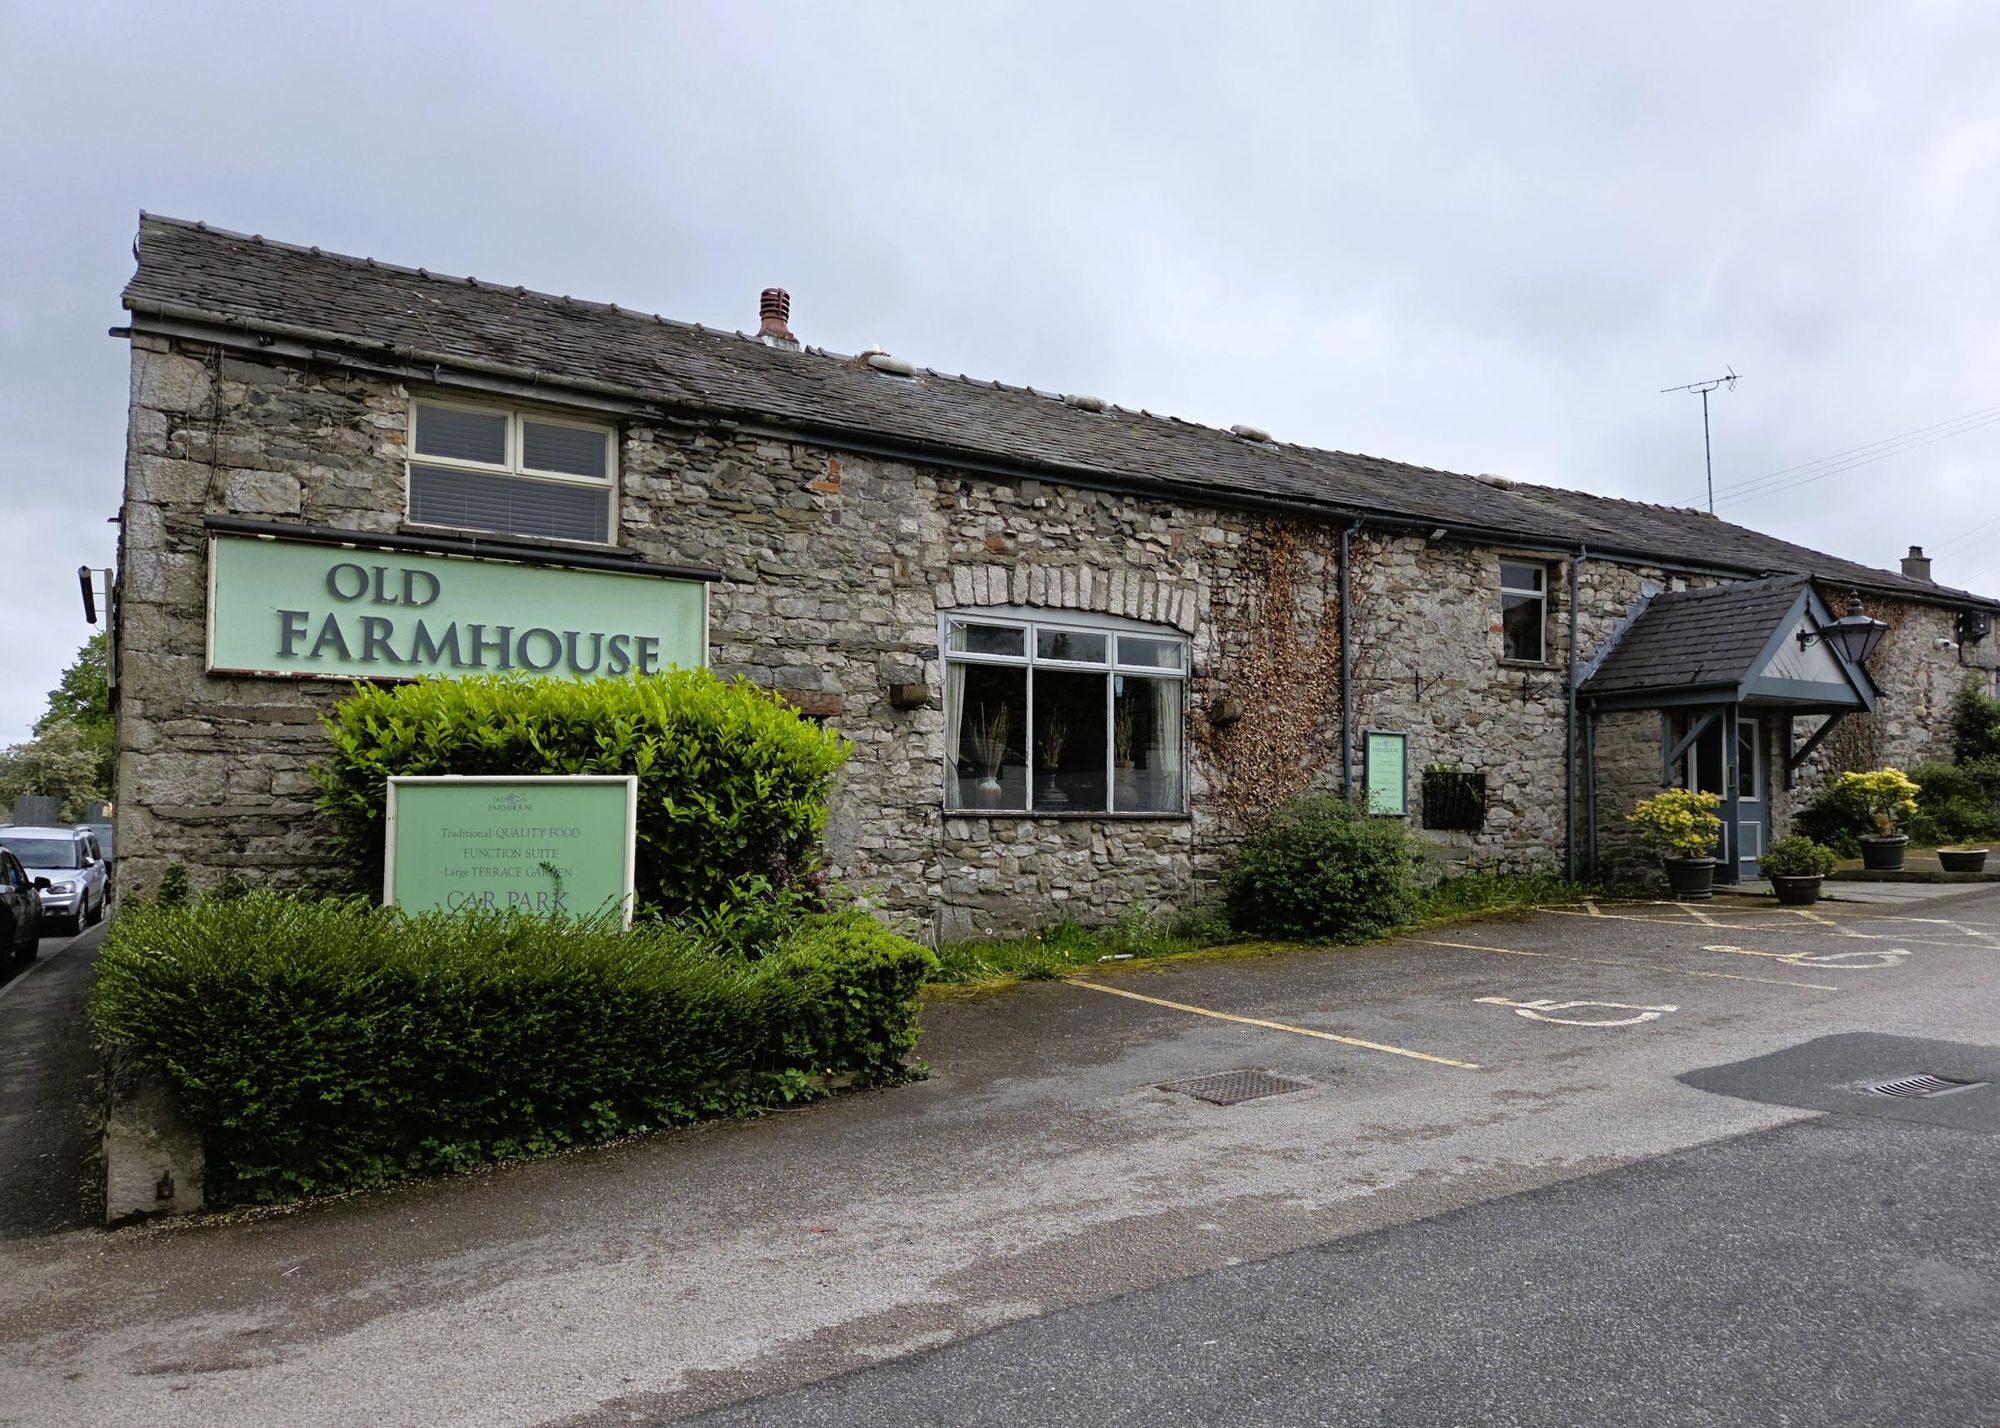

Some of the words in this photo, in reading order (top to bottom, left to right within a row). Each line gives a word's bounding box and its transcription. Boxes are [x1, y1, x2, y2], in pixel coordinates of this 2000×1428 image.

[326, 563, 441, 607] OLD
[276, 609, 660, 675] FARMHOUSE
[440, 828, 492, 839] Traditional
[496, 827, 546, 840] QUALITY
[550, 828, 581, 839] FOOD
[463, 848, 521, 859] FUNCTION
[525, 848, 558, 859] SUITE
[444, 866, 470, 879] Large
[472, 866, 522, 877] TERRACE
[525, 867, 572, 878] GAREN
[447, 889, 498, 914] CAR
[507, 891, 569, 913] PARK
